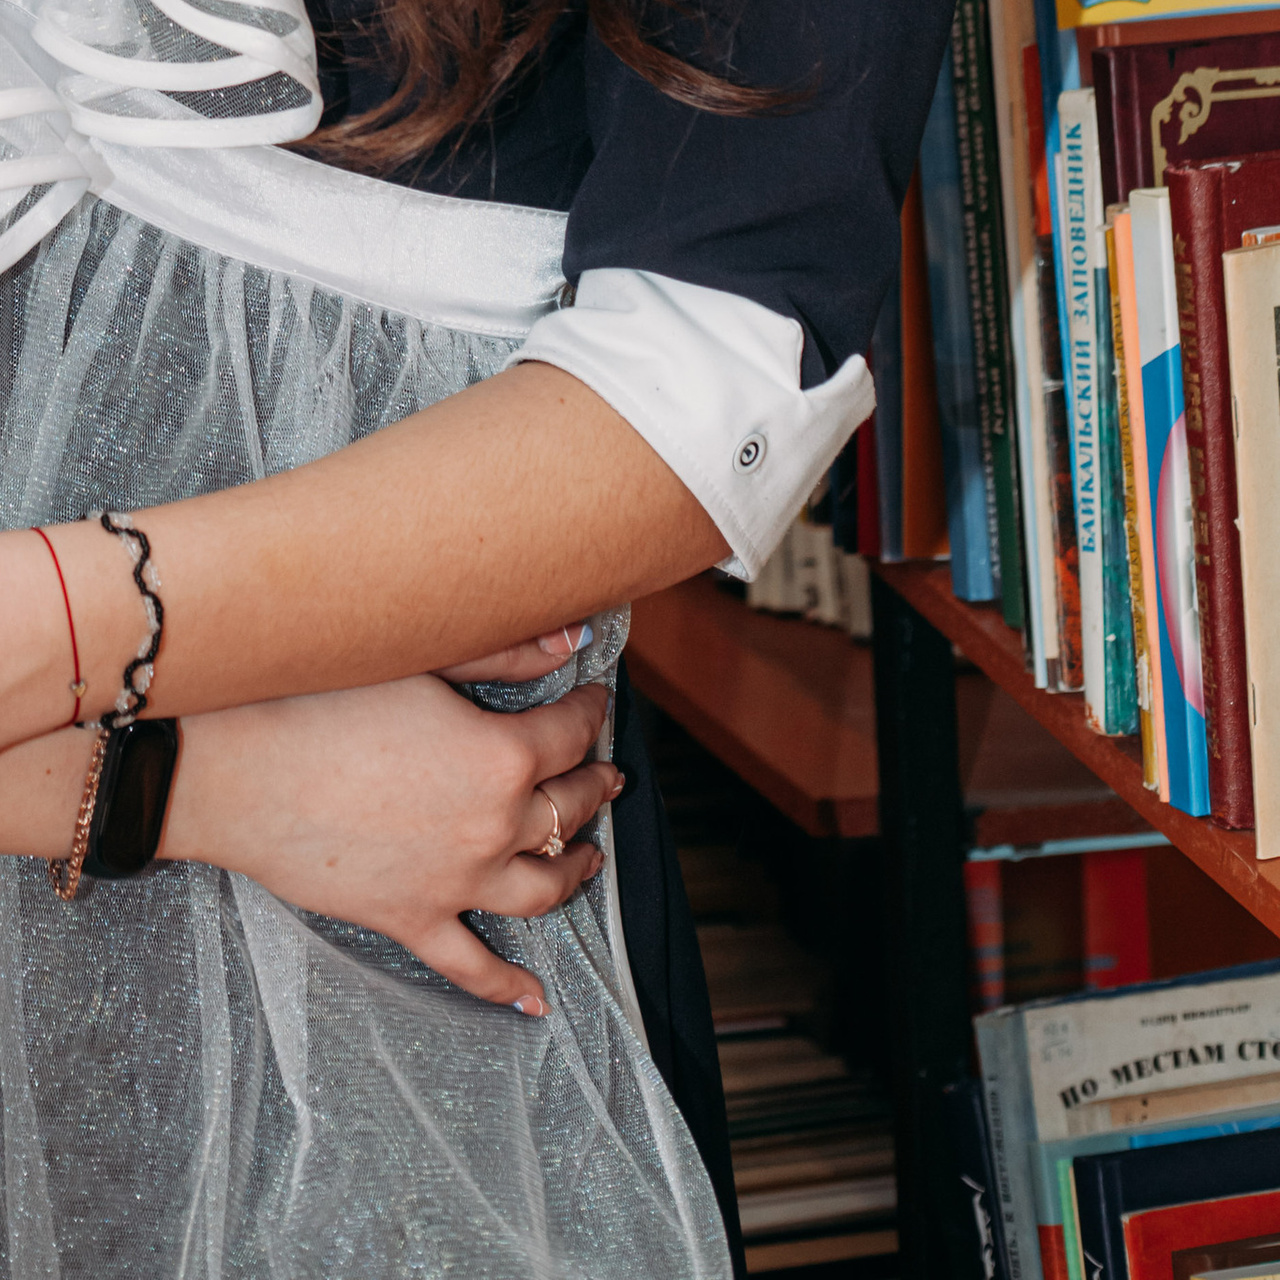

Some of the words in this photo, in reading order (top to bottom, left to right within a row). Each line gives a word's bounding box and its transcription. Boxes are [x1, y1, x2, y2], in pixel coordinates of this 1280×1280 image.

[1064, 122, 1091, 326] ЗАПОВЕДНИК
[1072, 340, 1097, 553] БАЙКАЛЬСКИЙ
[1058, 1077, 1100, 1111] ПО
[1109, 1041, 1227, 1087] МЕСТАМ
